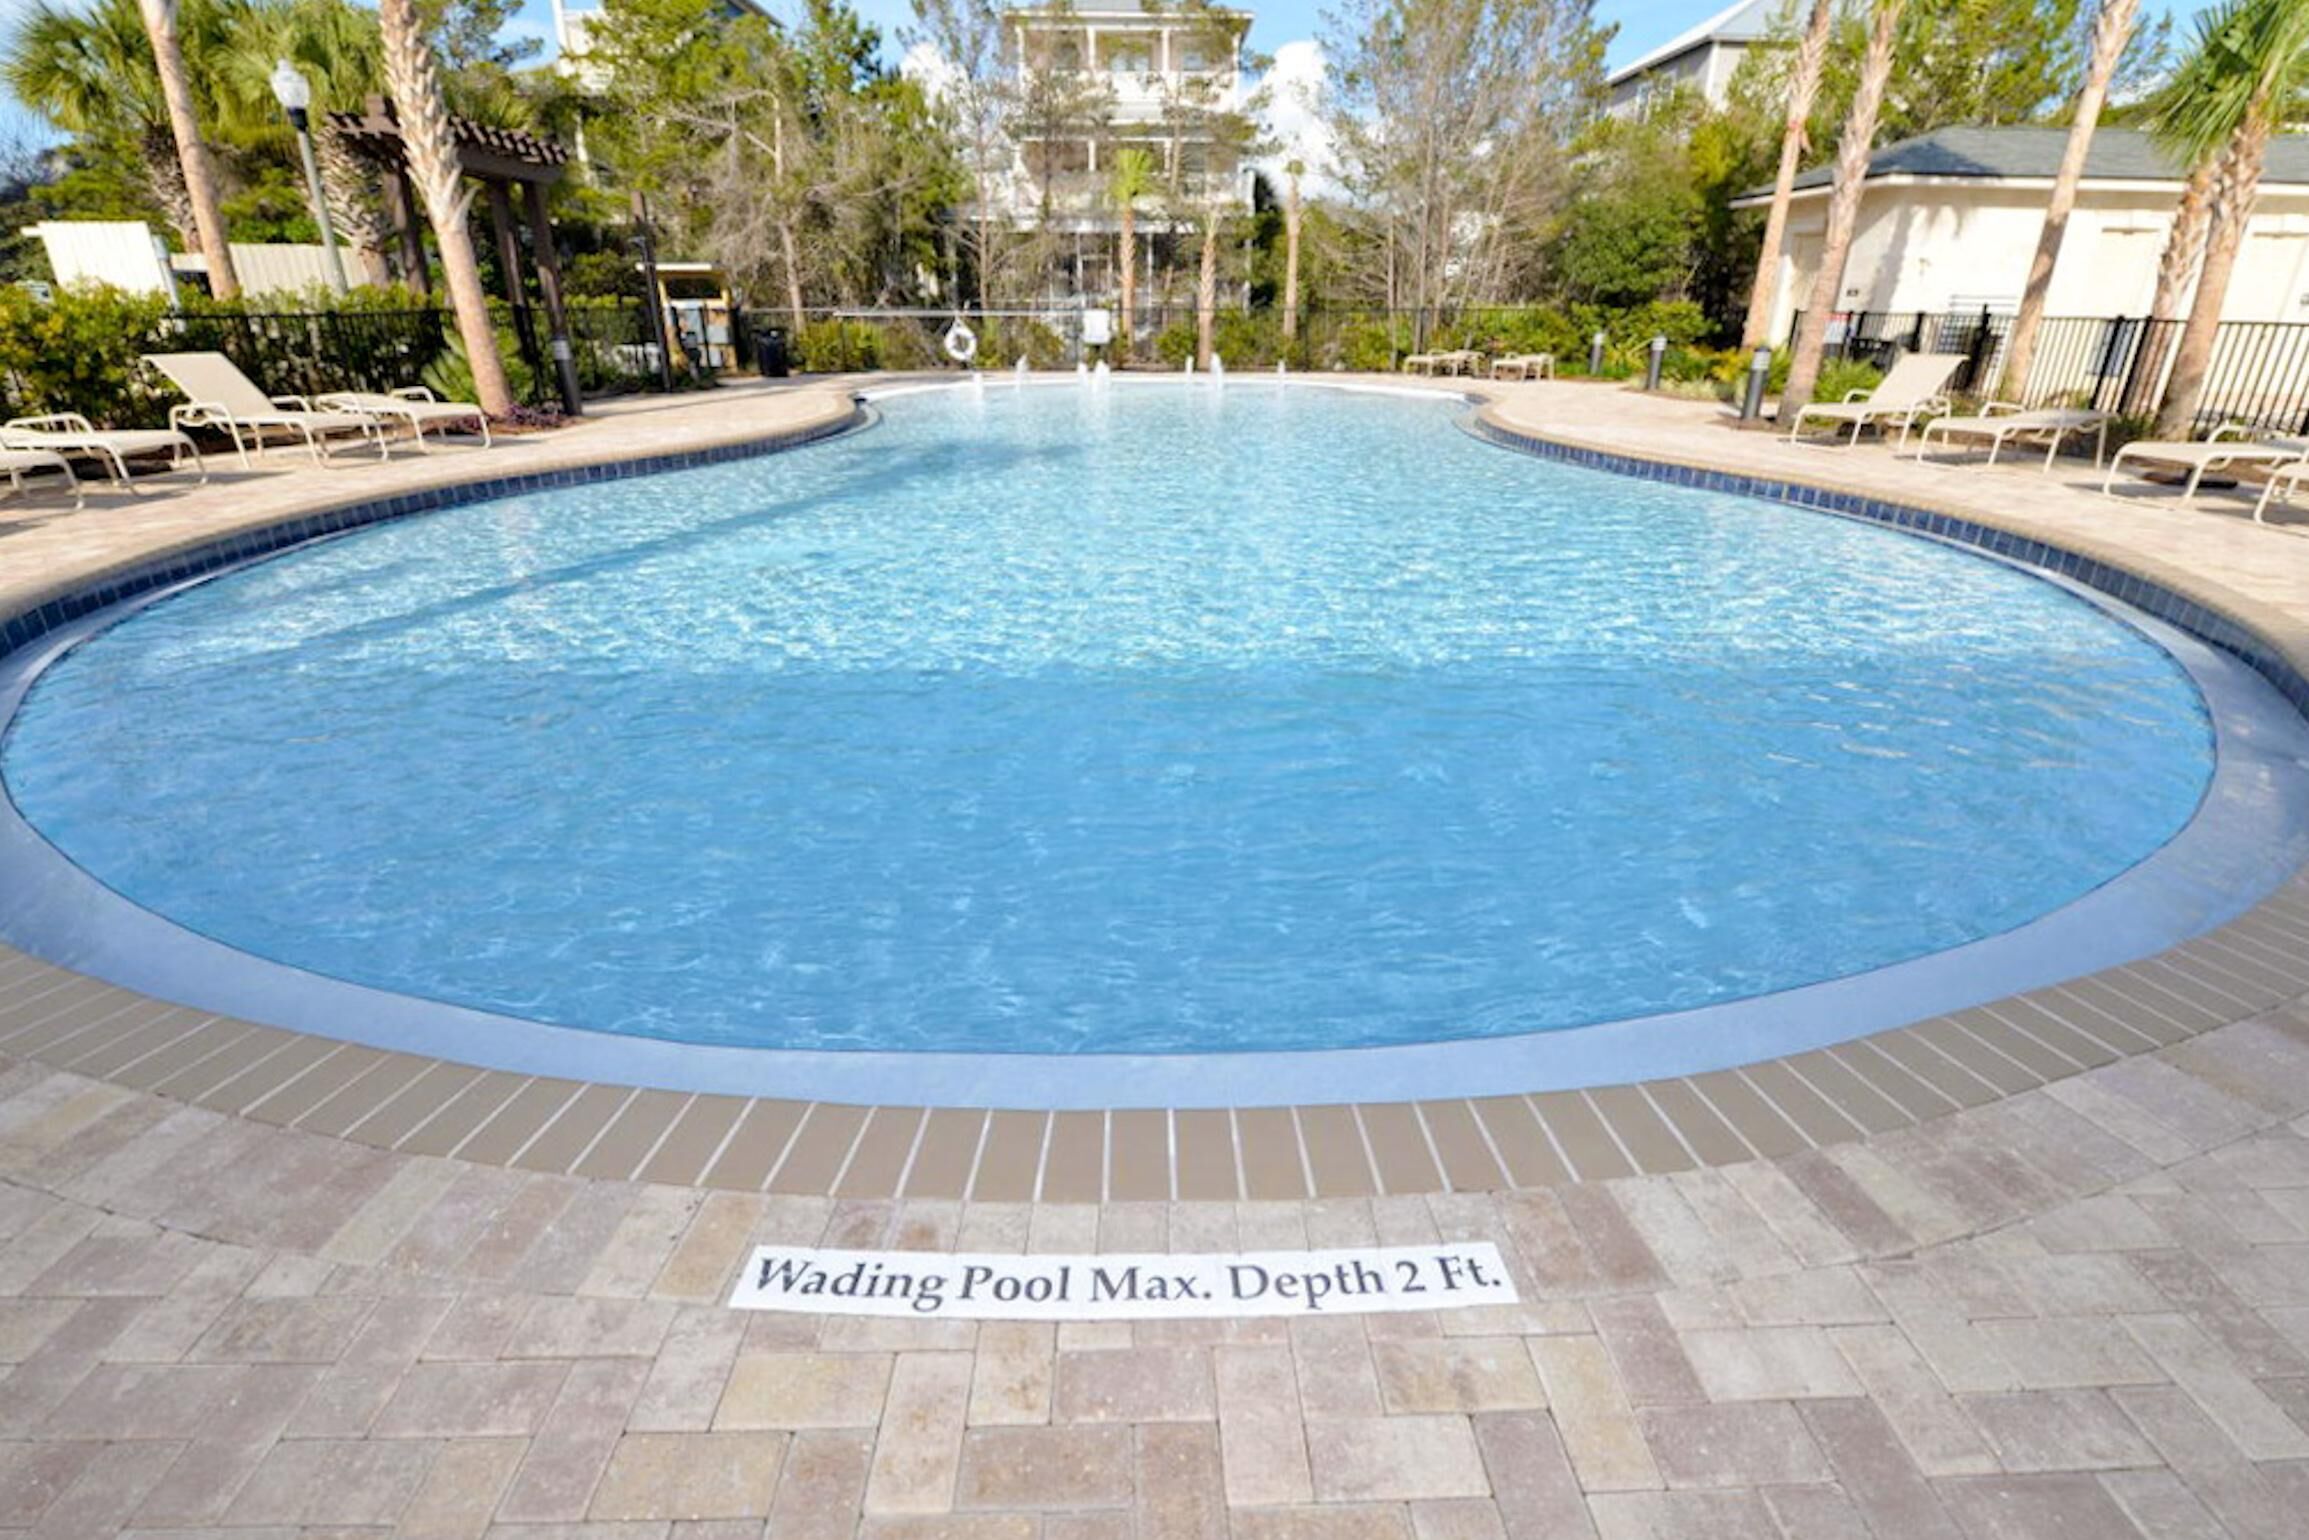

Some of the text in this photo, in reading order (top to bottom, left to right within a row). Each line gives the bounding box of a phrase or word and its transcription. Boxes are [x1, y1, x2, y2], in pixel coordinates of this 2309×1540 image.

[757, 1255, 1502, 1311] Wading Pool Max. Depth 2 Ft.
